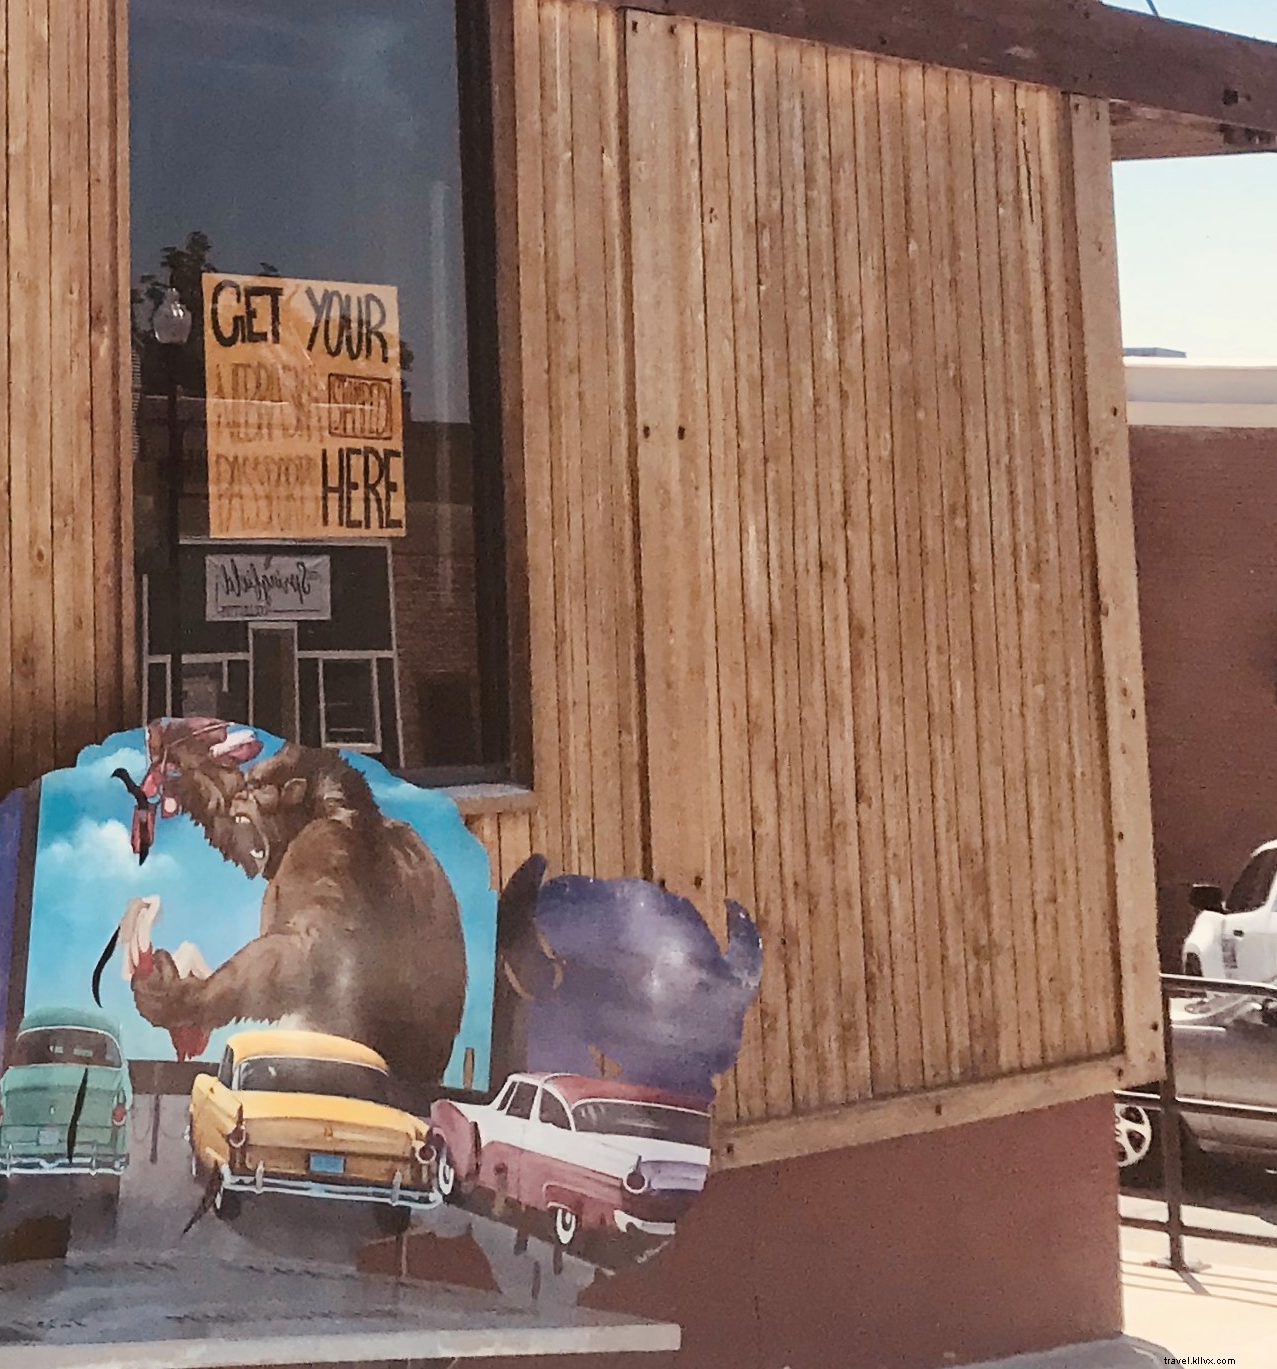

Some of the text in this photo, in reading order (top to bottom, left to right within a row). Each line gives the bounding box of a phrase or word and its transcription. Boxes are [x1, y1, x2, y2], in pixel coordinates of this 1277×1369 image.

[211, 280, 388, 363] GET YOUR
[321, 446, 402, 530] HERE
